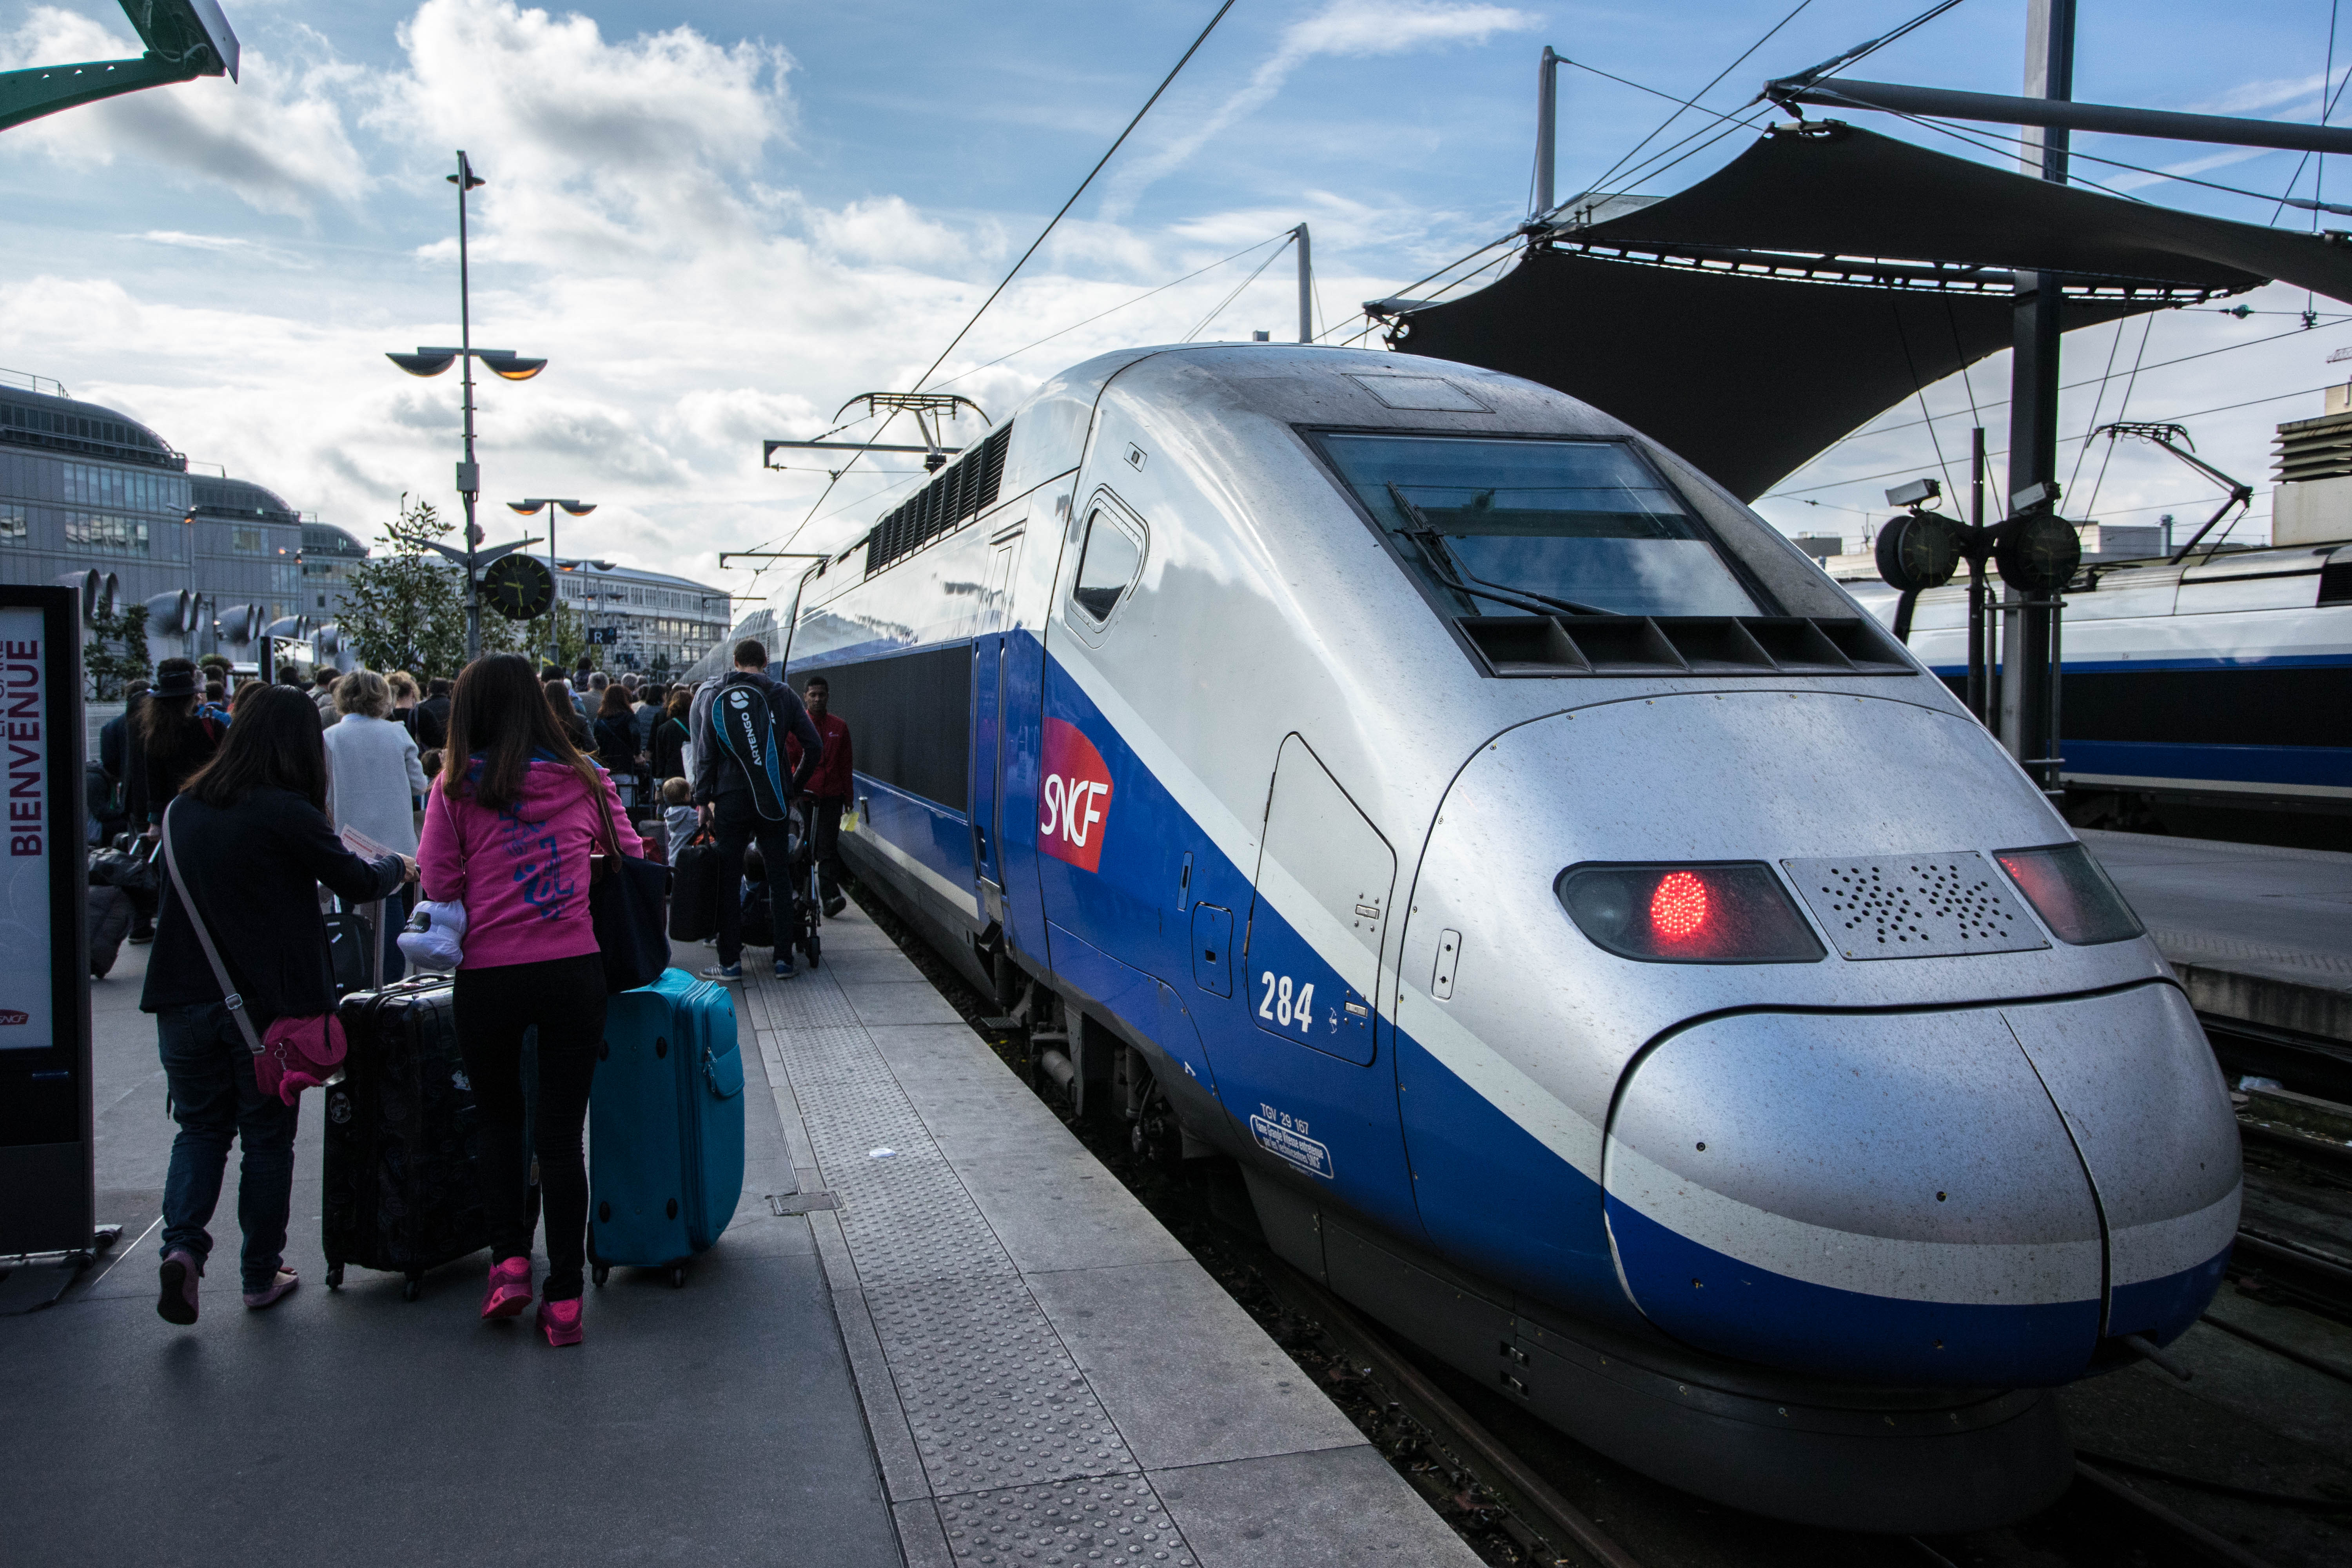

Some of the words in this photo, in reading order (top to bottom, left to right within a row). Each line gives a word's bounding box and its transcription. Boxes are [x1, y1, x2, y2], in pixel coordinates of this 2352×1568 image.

[594, 631, 603, 643] R
[6, 641, 42, 856] BIENVENUE
[741, 712, 762, 766] ARTENGO
[1041, 774, 1109, 847] SNCF
[1259, 971, 1314, 1033] 284
[1260, 1103, 1277, 1121] TGV
[1280, 1112, 1292, 1128] 29
[1294, 1118, 1308, 1135] 167
